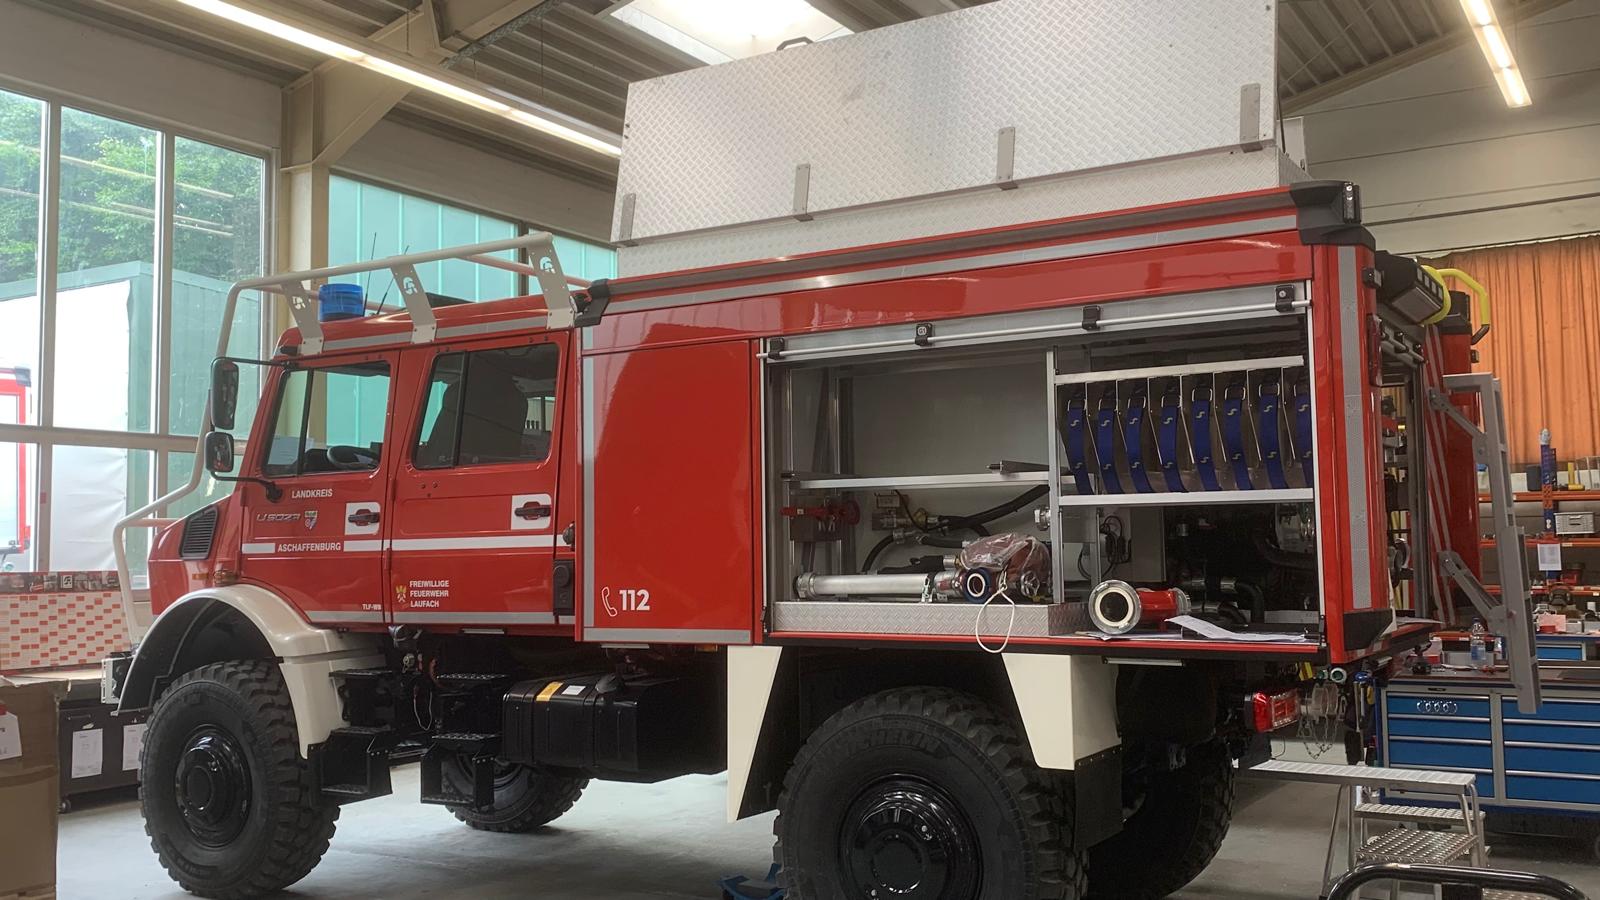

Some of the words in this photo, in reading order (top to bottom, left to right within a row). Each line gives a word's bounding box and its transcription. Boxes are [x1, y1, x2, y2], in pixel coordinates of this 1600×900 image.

[292, 489, 333, 498] LANDKREIS
[278, 542, 341, 552] ASCHAFFENBURG
[409, 580, 450, 588] FREIWILLIGE
[409, 590, 449, 598] FEUERWEHR
[410, 600, 440, 608] LAUFACH
[619, 589, 651, 611] 112
